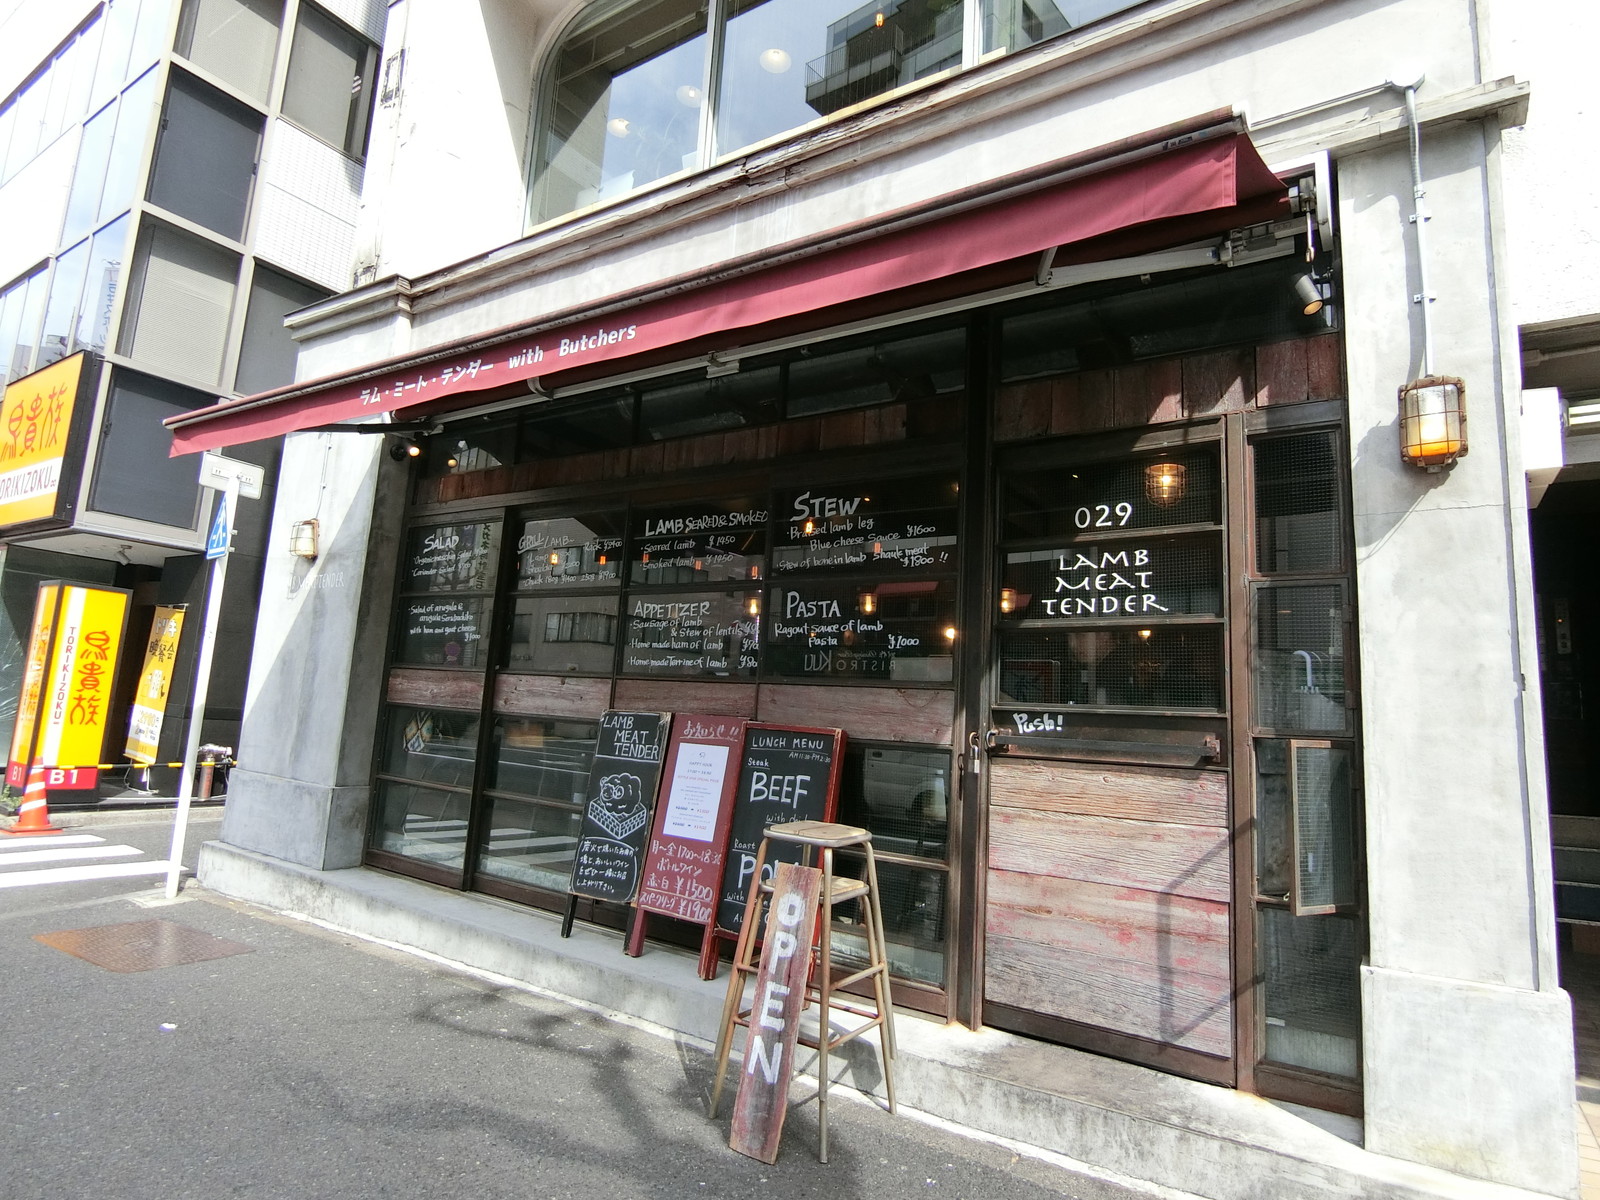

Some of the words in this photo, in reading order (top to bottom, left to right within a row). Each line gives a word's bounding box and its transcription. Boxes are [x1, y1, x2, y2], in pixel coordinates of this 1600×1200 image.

[360, 359, 494, 406] ラム・ミート・テンダー
[508, 346, 544, 369] with
[558, 324, 637, 357] Butchers
[0, 465, 53, 500] ORIKIZOKU
[790, 491, 861, 522] STEW
[1074, 502, 1133, 529] 029
[645, 518, 684, 537] LAMB
[685, 515, 719, 534] SEARED
[719, 514, 728, 528] &
[830, 520, 853, 535] lamb
[858, 516, 874, 530] leg
[422, 534, 460, 554] SALAD
[518, 533, 545, 550] GRILL
[673, 538, 696, 550] lamb
[707, 535, 736, 548] ¥1450
[810, 537, 832, 551] Blue
[833, 533, 865, 548] cheese
[906, 525, 936, 538] ¥1600
[675, 556, 696, 567] lamb
[779, 559, 799, 571] Stew
[800, 558, 811, 569] of
[813, 555, 834, 567] bone
[834, 554, 844, 564] in
[845, 552, 867, 563] lamb
[905, 542, 930, 555] meat
[900, 555, 934, 568] ¥1800
[1059, 549, 1149, 571] LAMB
[318, 571, 345, 589] TENDER
[1055, 571, 1153, 593] MEAT
[410, 604, 427, 615] Salad
[426, 603, 434, 612] of
[434, 602, 458, 613] arugula
[633, 600, 711, 619] APPETIZER
[786, 591, 842, 619] PASTA
[1041, 594, 1169, 615] TENDER
[410, 626, 422, 635] with
[423, 625, 434, 634] ham
[434, 626, 444, 634] and
[457, 624, 477, 633] cheese
[632, 619, 669, 631] Sausage
[669, 617, 680, 627] of
[681, 616, 702, 627] lamb
[670, 629, 677, 637] &
[679, 627, 701, 637] Stew
[703, 626, 715, 637] of
[715, 623, 743, 637] lentils
[774, 622, 810, 637] Ragout
[840, 620, 855, 632] of
[857, 619, 883, 633] lamb
[631, 638, 650, 648] Home
[651, 640, 670, 649] made
[671, 637, 689, 649] ham
[691, 640, 702, 649] of
[703, 638, 724, 649] lamb
[888, 634, 920, 649] ¥1000
[630, 656, 650, 666] Home
[650, 657, 669, 667] made
[694, 656, 704, 668] of
[706, 656, 728, 668] lamb
[54, 626, 77, 720] TORIKIZOKU
[70, 630, 111, 726] 鳥貴族
[603, 715, 635, 730] LAMB
[1012, 712, 1064, 734] Push!
[614, 730, 649, 745] MEAT
[752, 735, 787, 749] LUNCH
[792, 738, 824, 750] MENU
[613, 742, 660, 761] TENDER
[747, 757, 770, 768] Steak
[11, 765, 23, 782] B1
[49, 768, 80, 786] B1
[750, 771, 811, 809] BEEF
[766, 812, 786, 824] with
[734, 838, 756, 849] Roast
[657, 857, 703, 877] ボトルワイン
[674, 875, 714, 901] ¥1500
[726, 890, 745, 902] with
[678, 898, 713, 921] ¥1900
[747, 891, 806, 1085] OPEN
